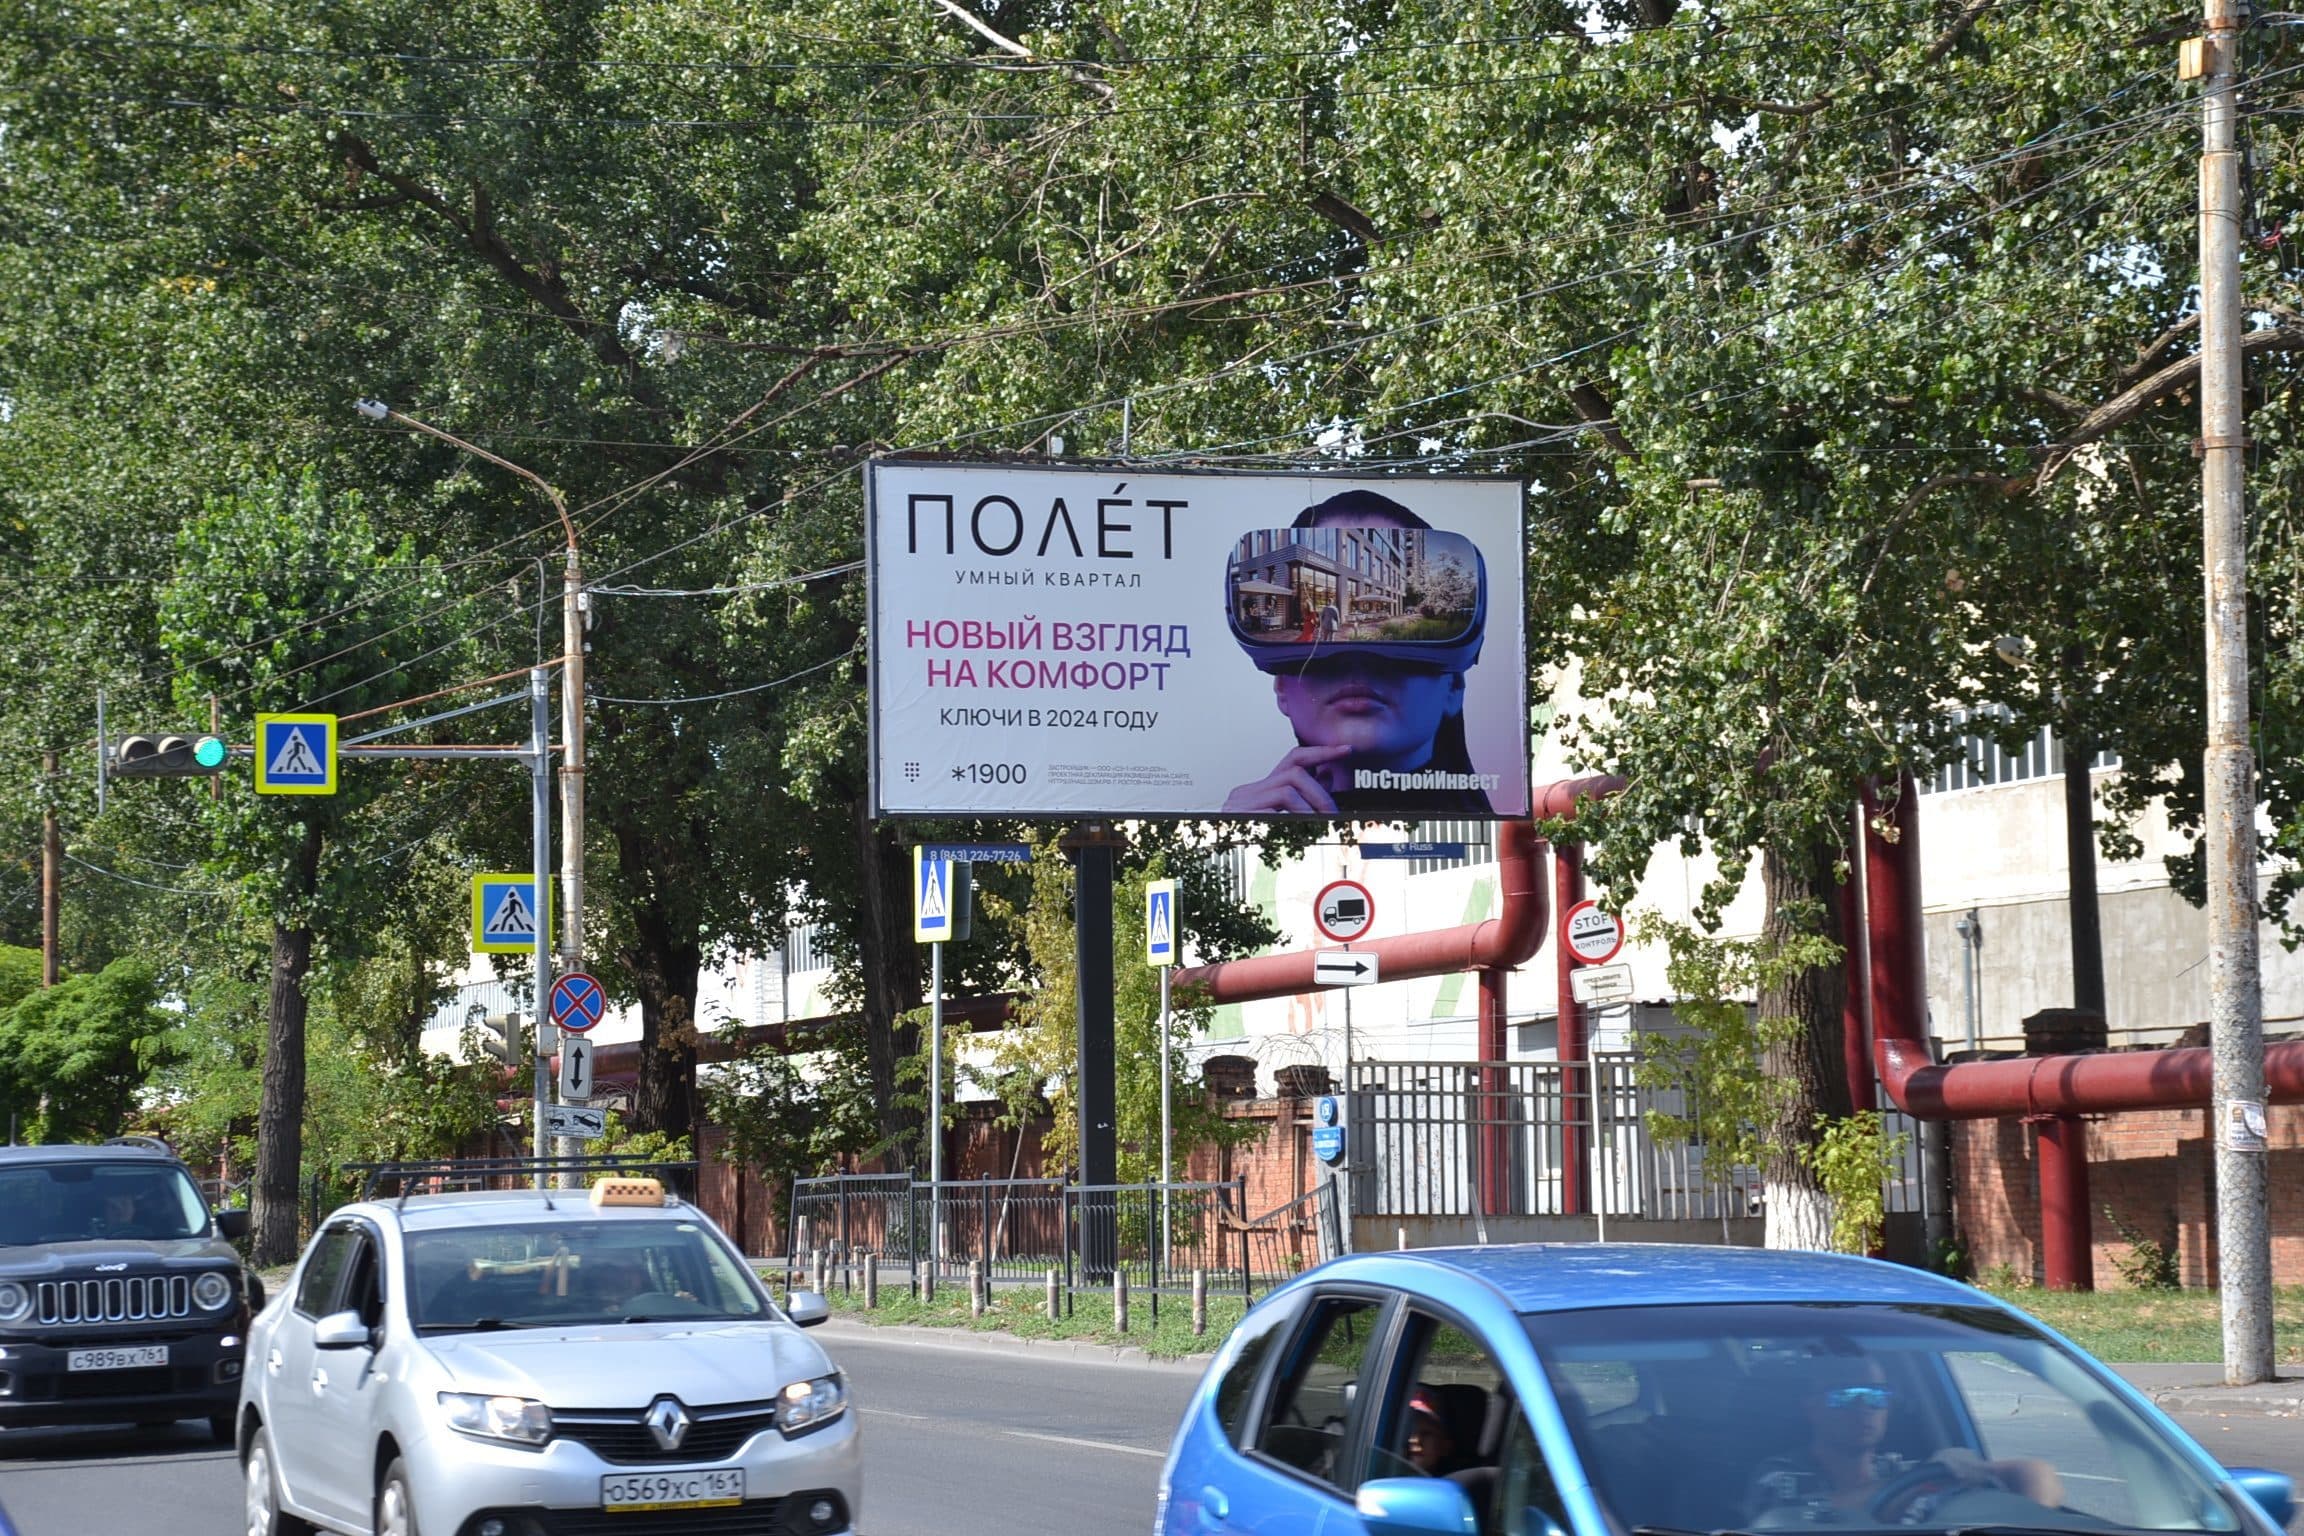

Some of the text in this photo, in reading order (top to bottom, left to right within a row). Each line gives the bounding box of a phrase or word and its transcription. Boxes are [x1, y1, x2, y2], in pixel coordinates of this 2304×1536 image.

[954, 568, 1142, 588] УМНЫЙ КВАРТАЛ
[906, 614, 1191, 658] НОВЫЙ ВЗГЛЯД
[927, 659, 1171, 691] НА КОМФОРТ
[940, 708, 1159, 731] КЛЮЧИ В 2024 ГОДУ
[1354, 768, 1500, 791] ЮгСтройИнвест
[930, 850, 937, 861] 8
[940, 849, 967, 862] (863)
[1409, 842, 1433, 851] Russ
[1575, 937, 1616, 949] КОНТРОЛЬ
